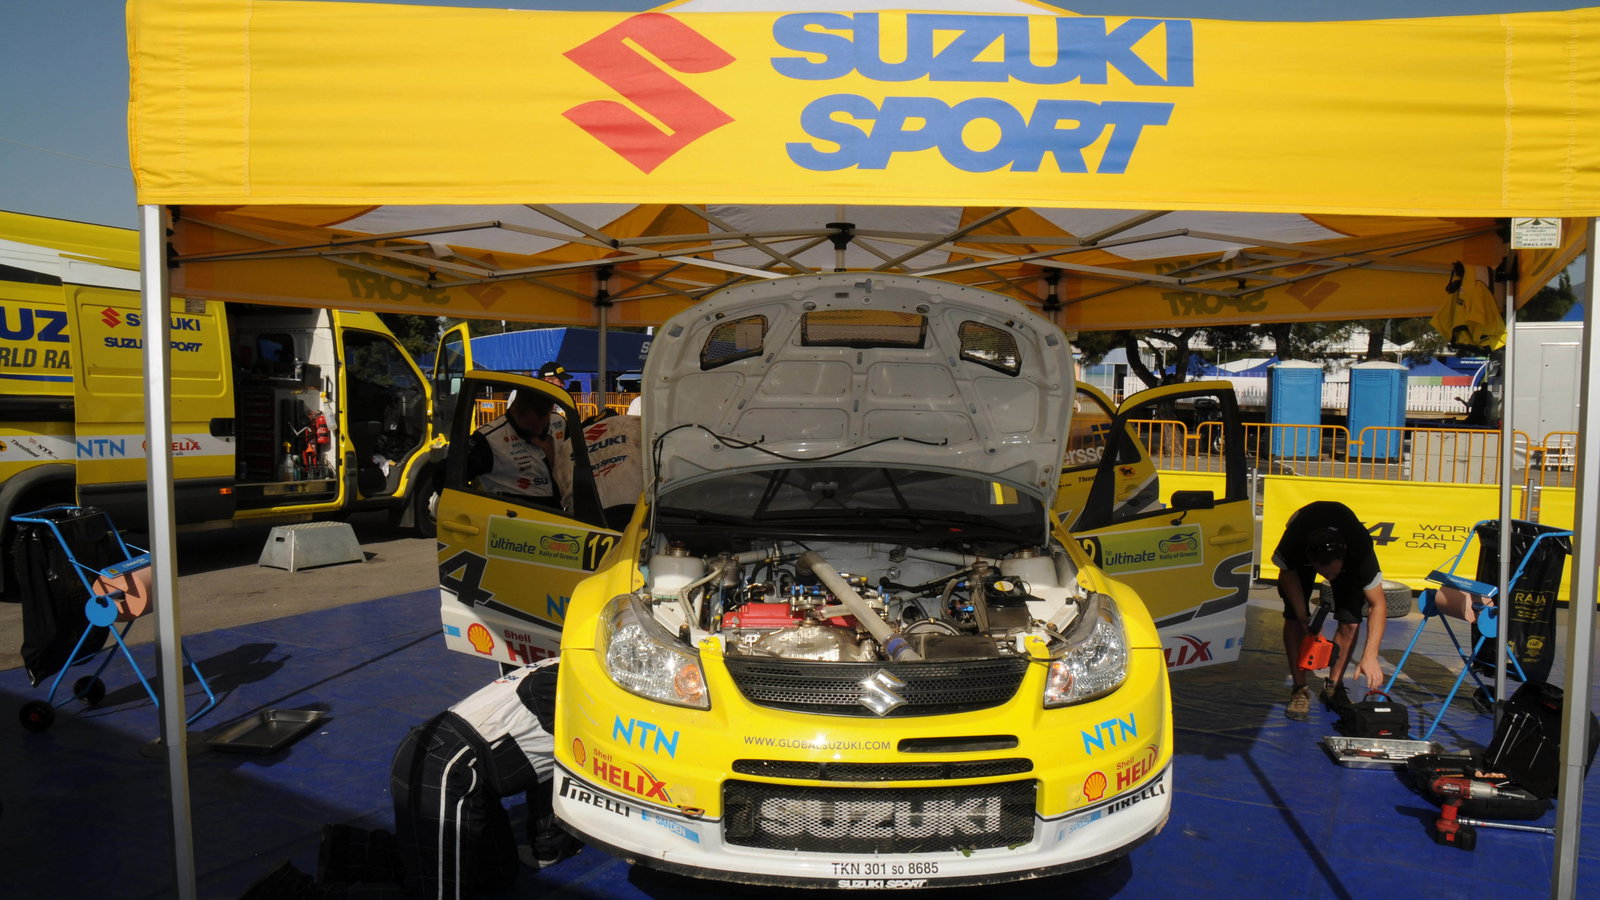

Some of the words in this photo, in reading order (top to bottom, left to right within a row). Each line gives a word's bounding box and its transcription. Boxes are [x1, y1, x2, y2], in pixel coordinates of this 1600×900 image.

[770, 12, 1194, 87] SUZUKI
[785, 93, 1174, 173] SPORT
[126, 313, 201, 332] SUKI
[104, 336, 143, 350] SUZU
[169, 341, 203, 353] PORT
[43, 349, 72, 370] RA
[77, 439, 125, 457] NTN
[171, 438, 201, 451] ELIX
[490, 538, 536, 555] ultimate
[588, 534, 614, 570] 12
[1405, 541, 1447, 550] CAR
[1105, 550, 1155, 566] ultimate
[1514, 592, 1547, 605] RAJA
[504, 630, 531, 643] Shell
[612, 714, 680, 759] NTN
[1081, 713, 1138, 755] NTN
[593, 748, 613, 763] Shell
[1117, 757, 1135, 770] Shell
[593, 757, 671, 803] HELIX
[560, 777, 630, 817] PIRELLI
[655, 815, 686, 837] SANDEN
[761, 797, 1000, 839] SUZUKI
[832, 862, 860, 875] TKN
[864, 862, 886, 875] 301
[908, 862, 939, 874] 8685
[838, 880, 884, 889] SUZUKI
[885, 880, 927, 889] SPORT
